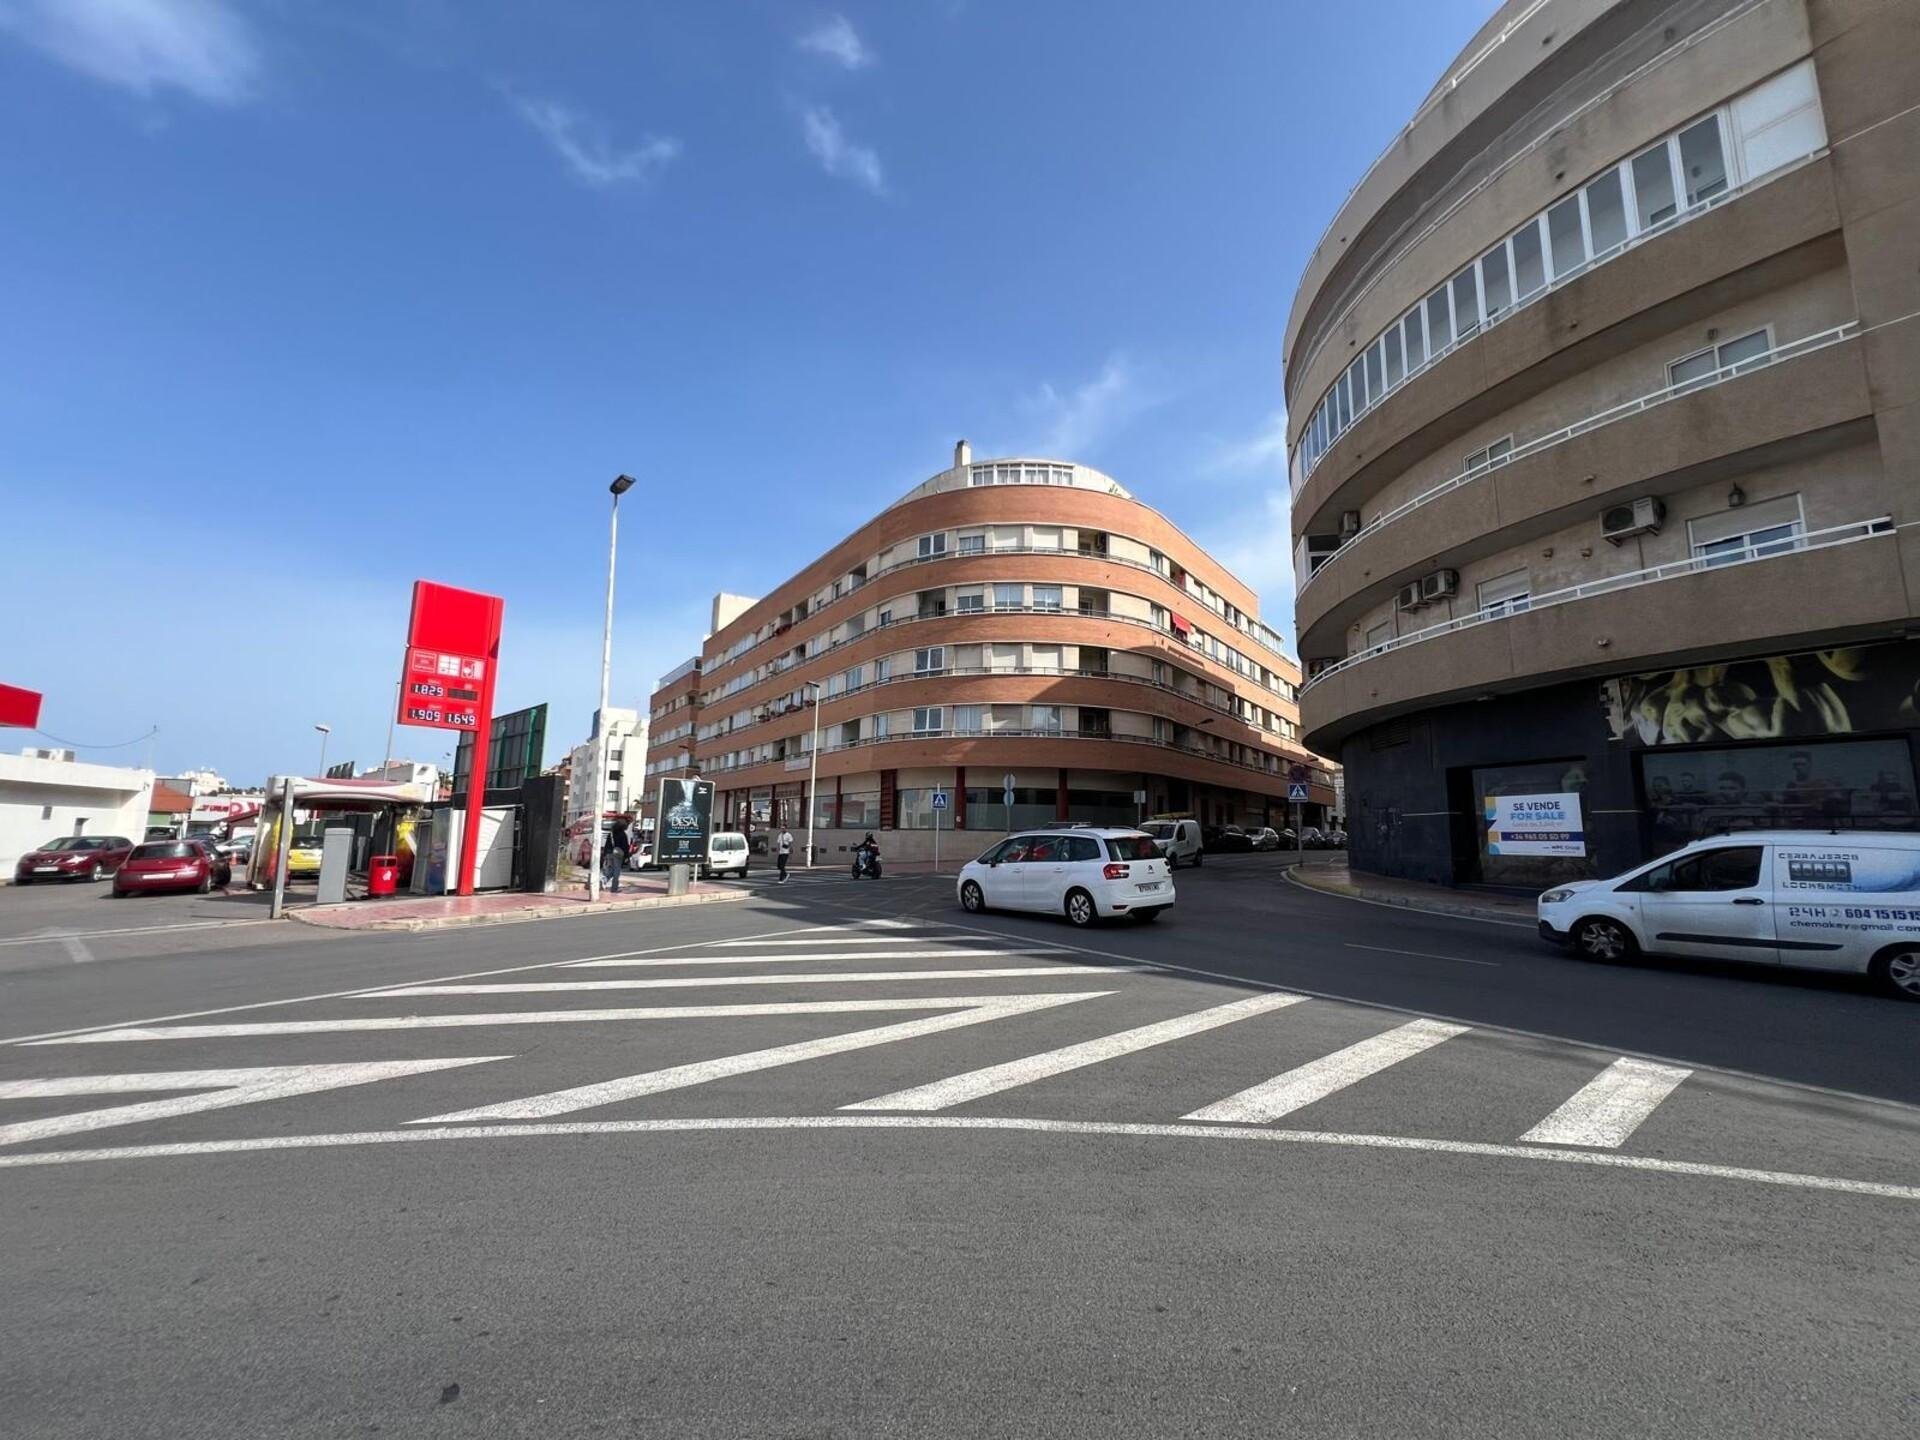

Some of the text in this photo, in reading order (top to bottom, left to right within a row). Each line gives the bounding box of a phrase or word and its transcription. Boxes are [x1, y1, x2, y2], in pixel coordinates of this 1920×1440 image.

[414, 684, 444, 697] 1.829
[411, 709, 441, 722] 1.909
[447, 713, 476, 726] 1.649
[1513, 801, 1561, 811] SE VENDE
[1510, 811, 1567, 821] FOR SALE
[1788, 907, 1827, 918] 24H
